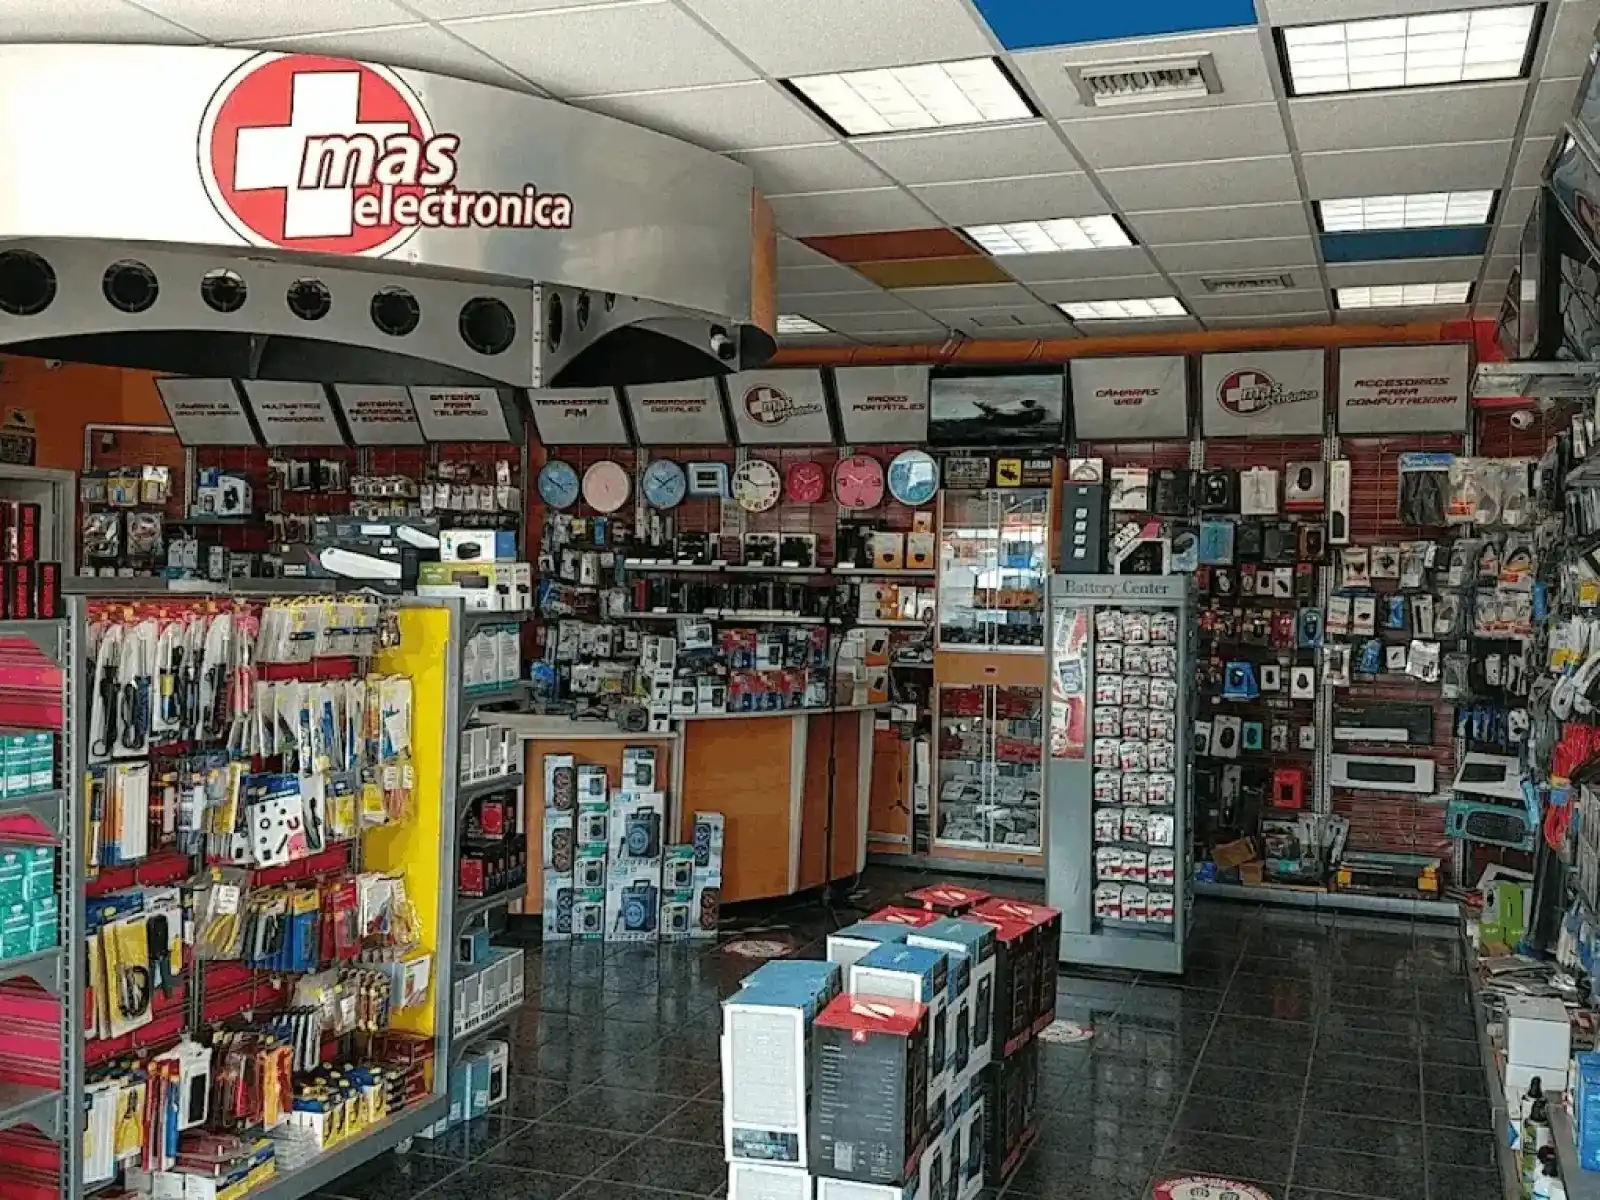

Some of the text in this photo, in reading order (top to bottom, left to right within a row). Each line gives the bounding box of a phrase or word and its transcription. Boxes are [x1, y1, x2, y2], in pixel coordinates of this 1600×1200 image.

[298, 133, 460, 190] mas
[353, 183, 572, 228] electronica
[1354, 377, 1450, 387] ACCESORIOS
[1378, 388, 1418, 396] PARA
[1113, 398, 1143, 406] WEB
[1345, 396, 1458, 407] COMPUTADORA
[564, 408, 587, 418] FM
[1064, 579, 1170, 596] Battery Center
